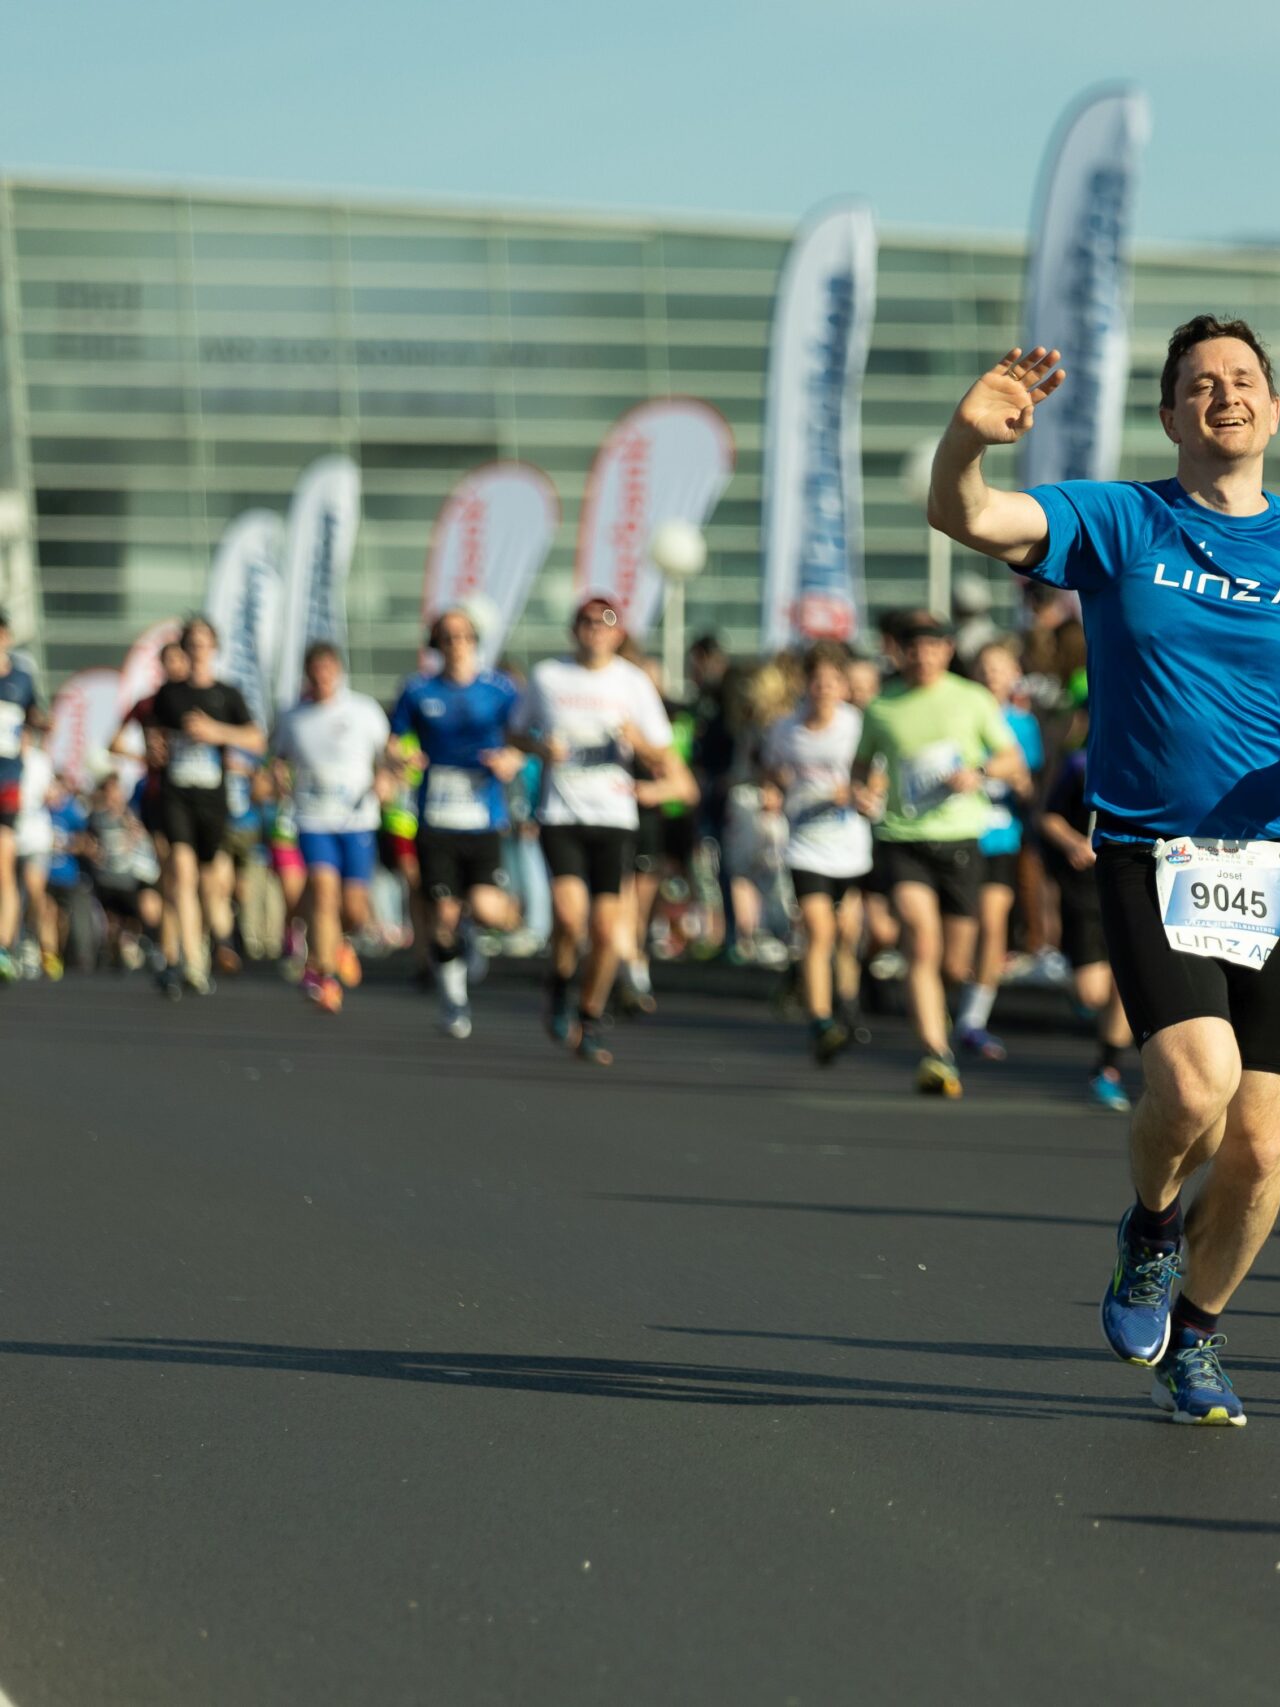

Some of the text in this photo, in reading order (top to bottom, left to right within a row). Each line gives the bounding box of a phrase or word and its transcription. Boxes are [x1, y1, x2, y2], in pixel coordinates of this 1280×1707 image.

[1153, 563, 1261, 602] LINZ
[1190, 882, 1268, 919] 9045
[1176, 932, 1241, 956] LINZ
